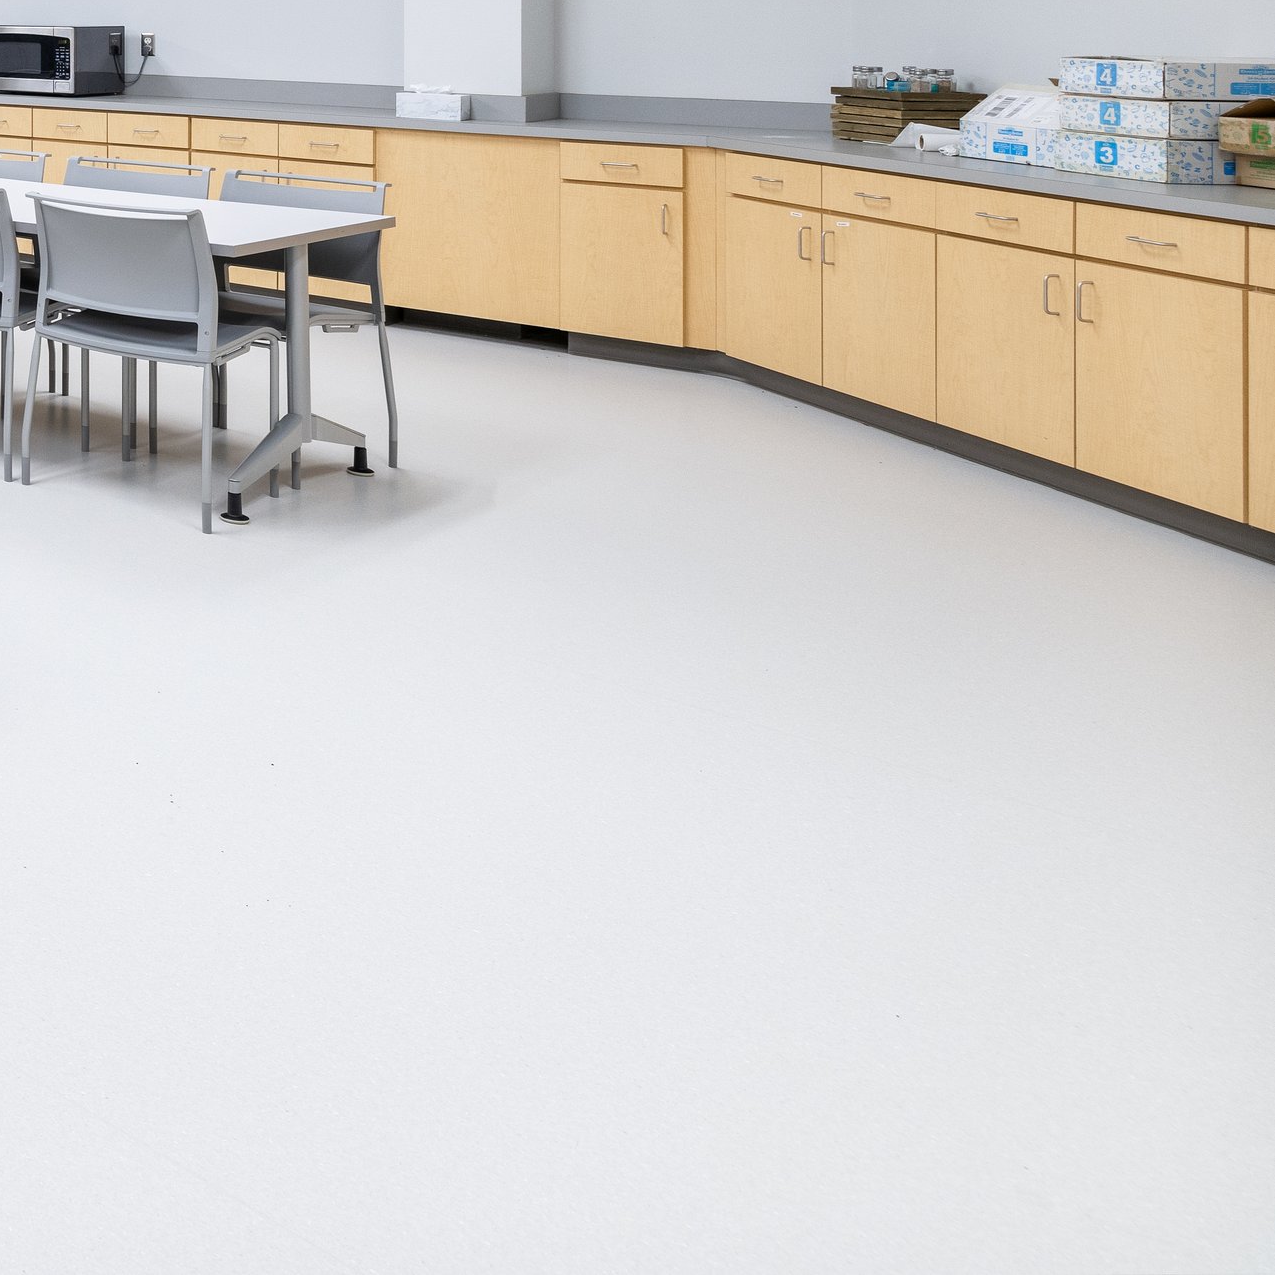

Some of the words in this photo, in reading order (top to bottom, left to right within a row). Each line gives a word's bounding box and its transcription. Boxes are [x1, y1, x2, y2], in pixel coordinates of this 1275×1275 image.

[1099, 68, 1113, 85] 4
[1103, 107, 1117, 124] 4
[1099, 146, 1114, 164] 3
